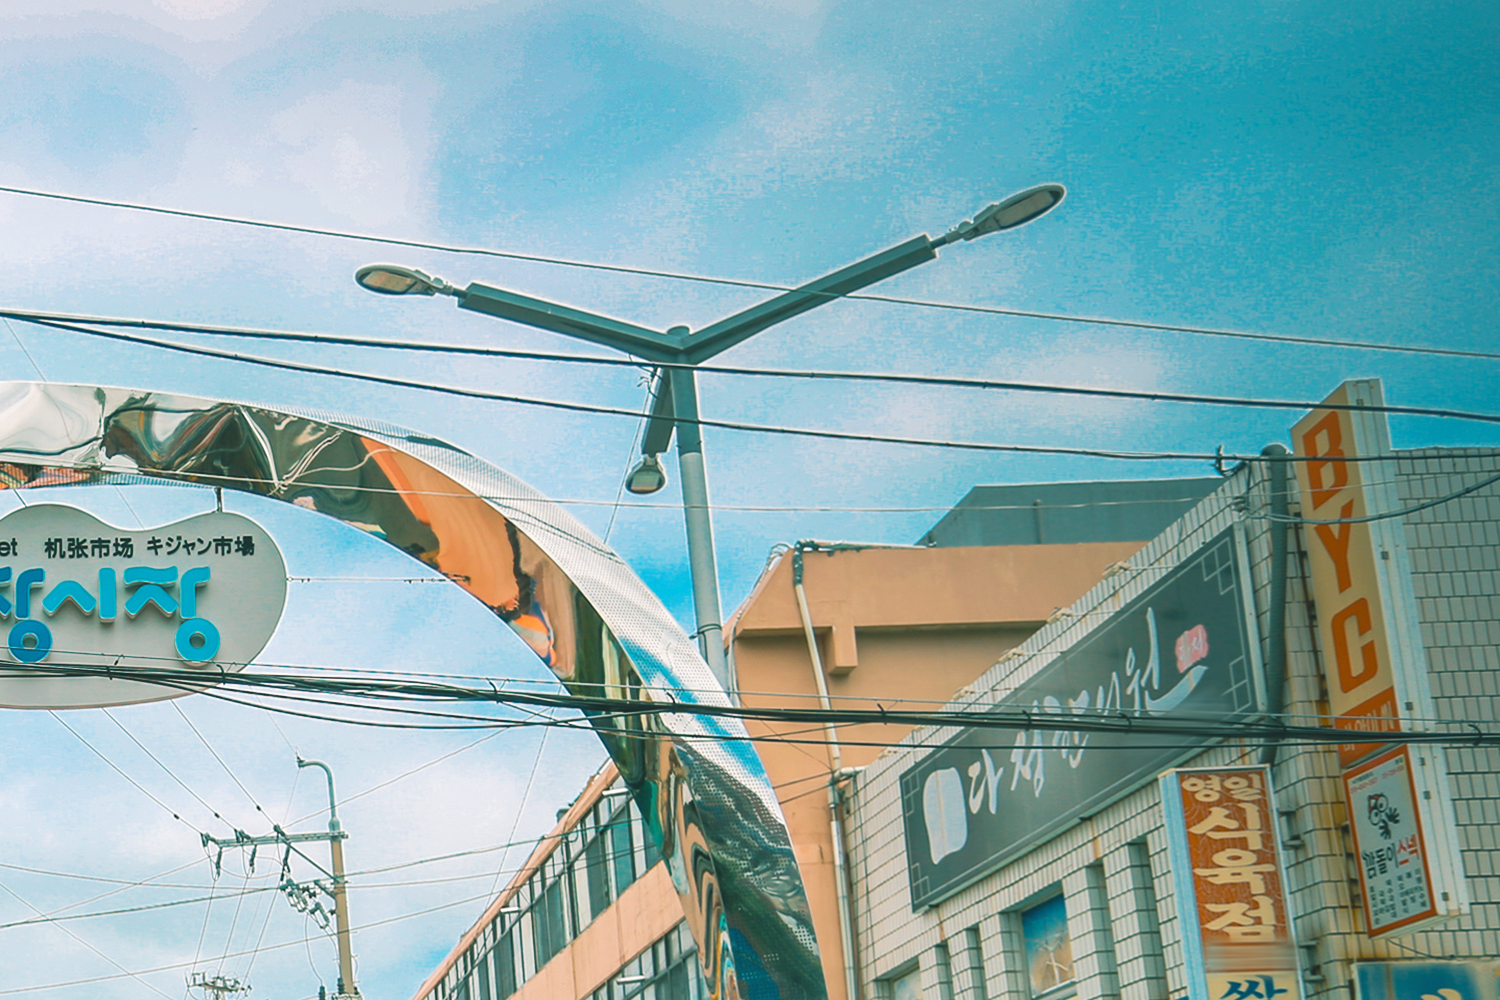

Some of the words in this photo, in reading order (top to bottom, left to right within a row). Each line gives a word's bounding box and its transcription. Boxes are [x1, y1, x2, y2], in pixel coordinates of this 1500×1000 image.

[44, 537, 134, 560] 机张市场
[146, 535, 255, 558] キジャン市場
[1303, 410, 1378, 694] BYC
[1187, 805, 1280, 944] 식육점
